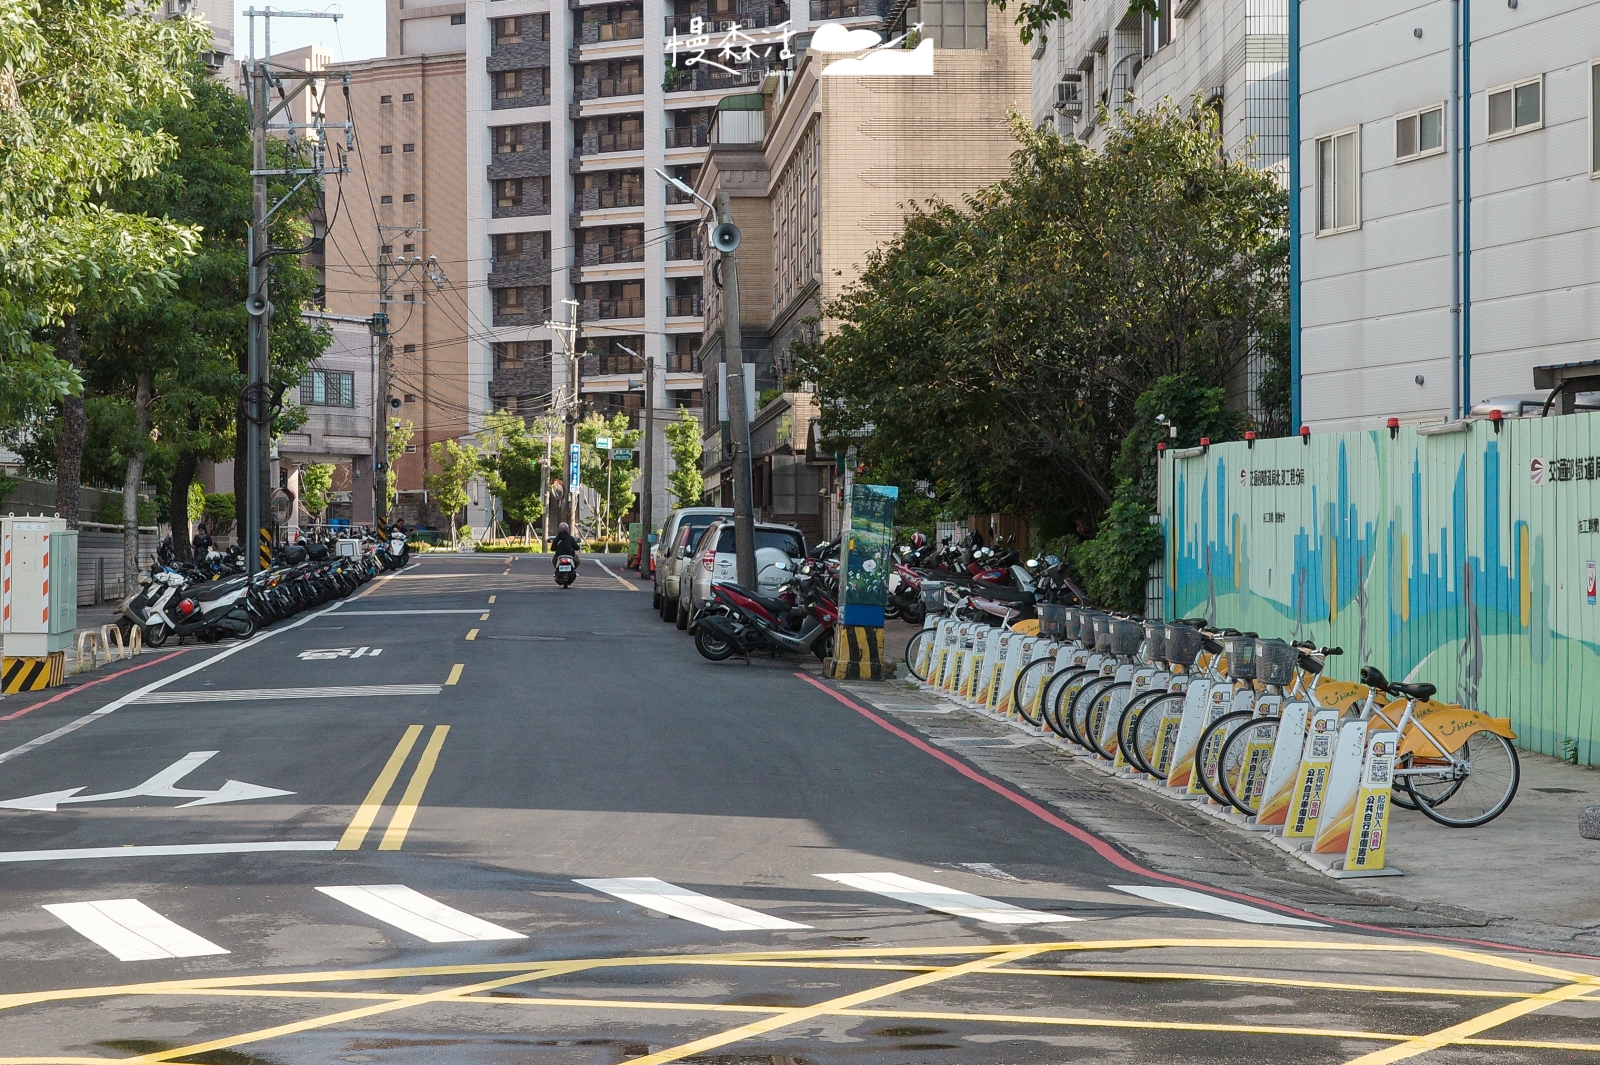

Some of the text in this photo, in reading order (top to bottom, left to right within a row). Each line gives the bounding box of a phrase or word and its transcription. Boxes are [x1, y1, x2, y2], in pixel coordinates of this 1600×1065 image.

[1243, 749, 1260, 806] 公共自行車傷害
[1295, 769, 1315, 833] 公共自行車傷害險
[1309, 768, 1326, 817] 記得加入 免費
[1356, 795, 1376, 866] 公共自行車傷害險
[1371, 795, 1386, 847] 記得加入 免費
